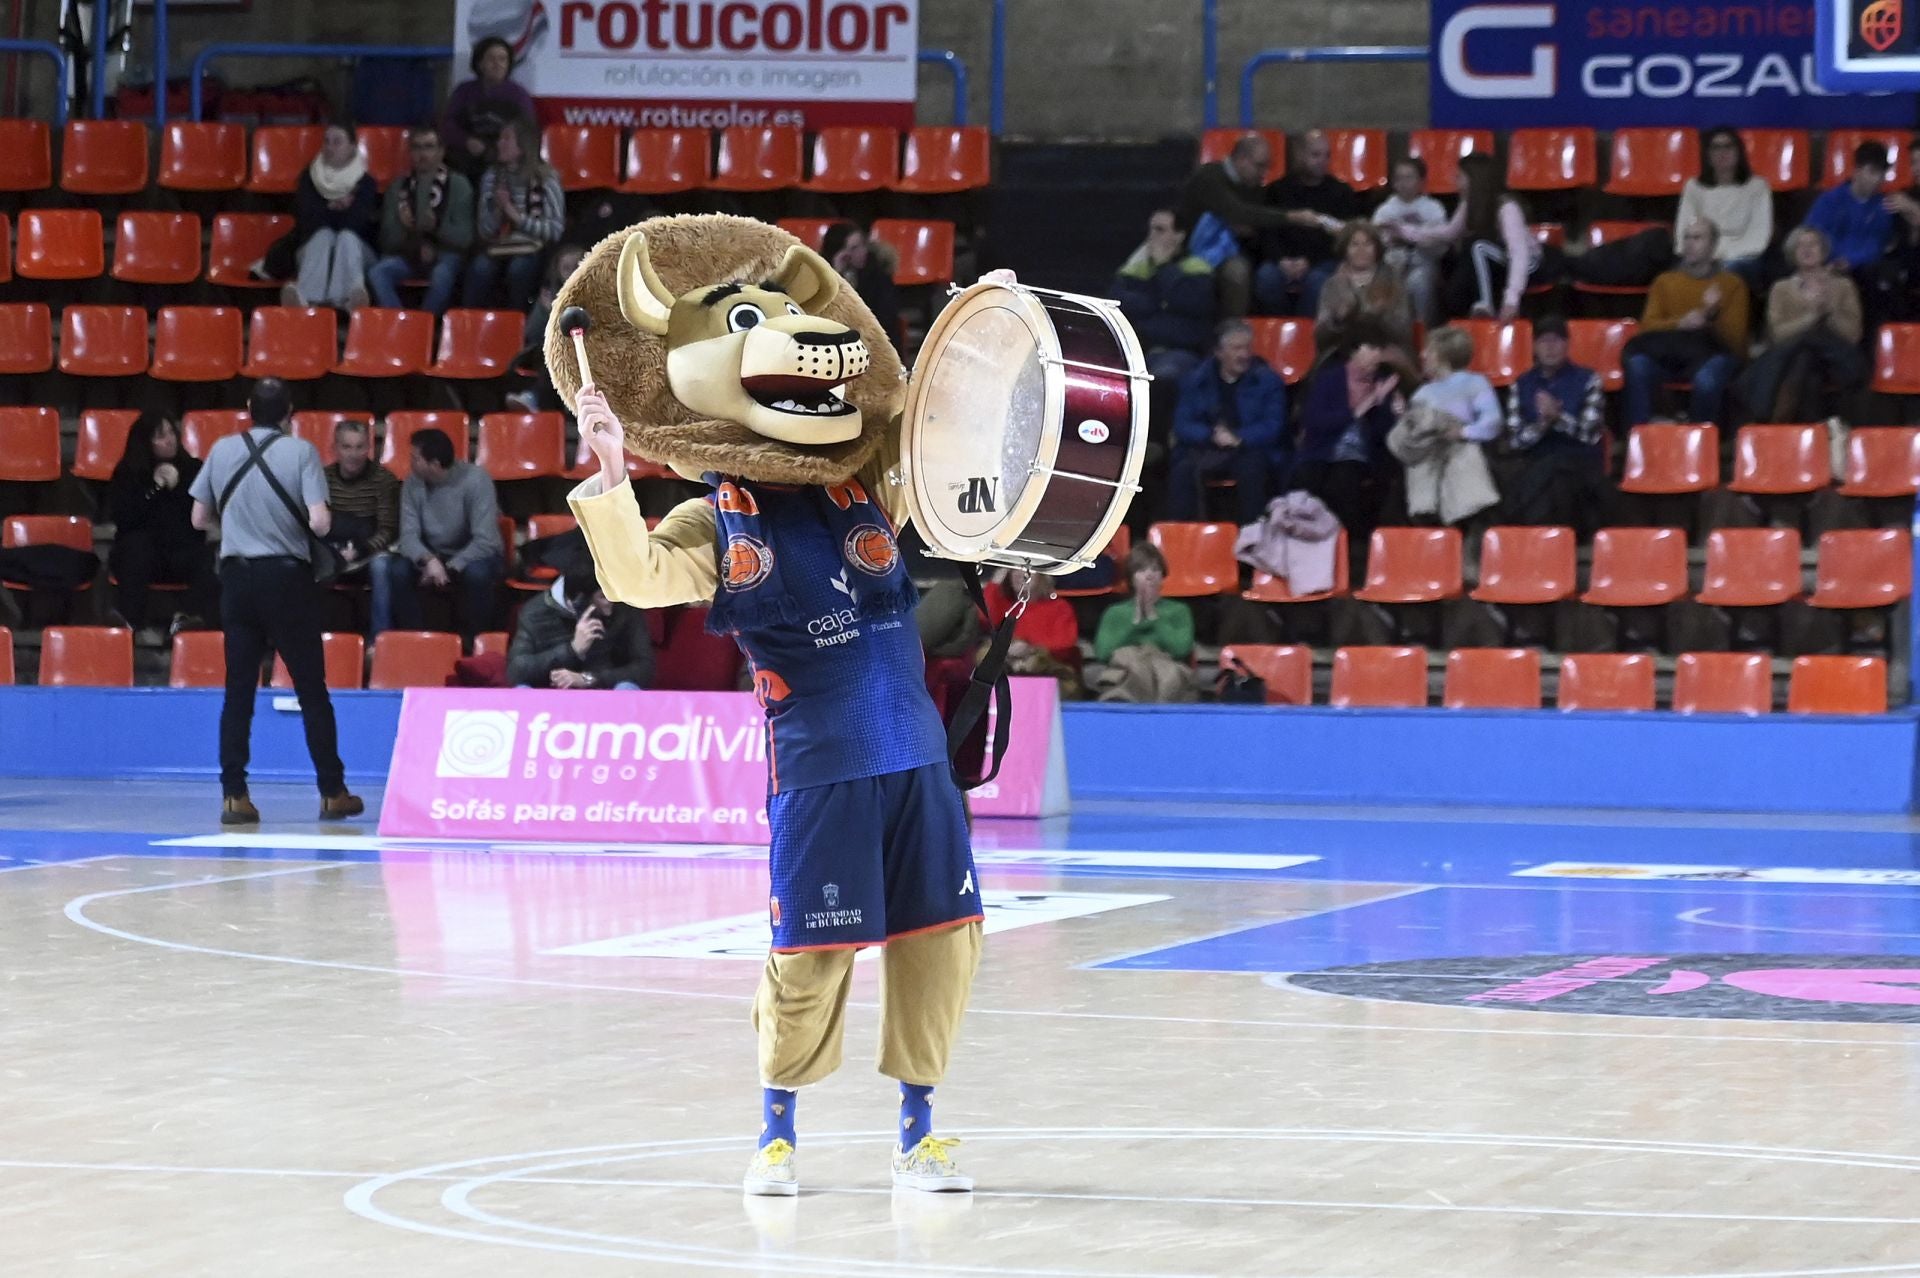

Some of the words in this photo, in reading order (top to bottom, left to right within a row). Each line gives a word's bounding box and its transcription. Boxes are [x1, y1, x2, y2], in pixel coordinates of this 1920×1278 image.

[560, 0, 909, 52] rotucolor
[604, 63, 731, 87] rotulación
[761, 67, 861, 93] imagen
[957, 476, 999, 513] NP
[814, 628, 860, 649] Burgos
[523, 760, 658, 785] Burgos
[429, 797, 507, 821] Sofás
[513, 802, 577, 825] para
[584, 800, 707, 824] disfrutar
[711, 805, 748, 825] en
[805, 908, 862, 921] UNIVERSIDAD
[806, 921, 817, 929] DE
[818, 915, 863, 928] BURGOS
